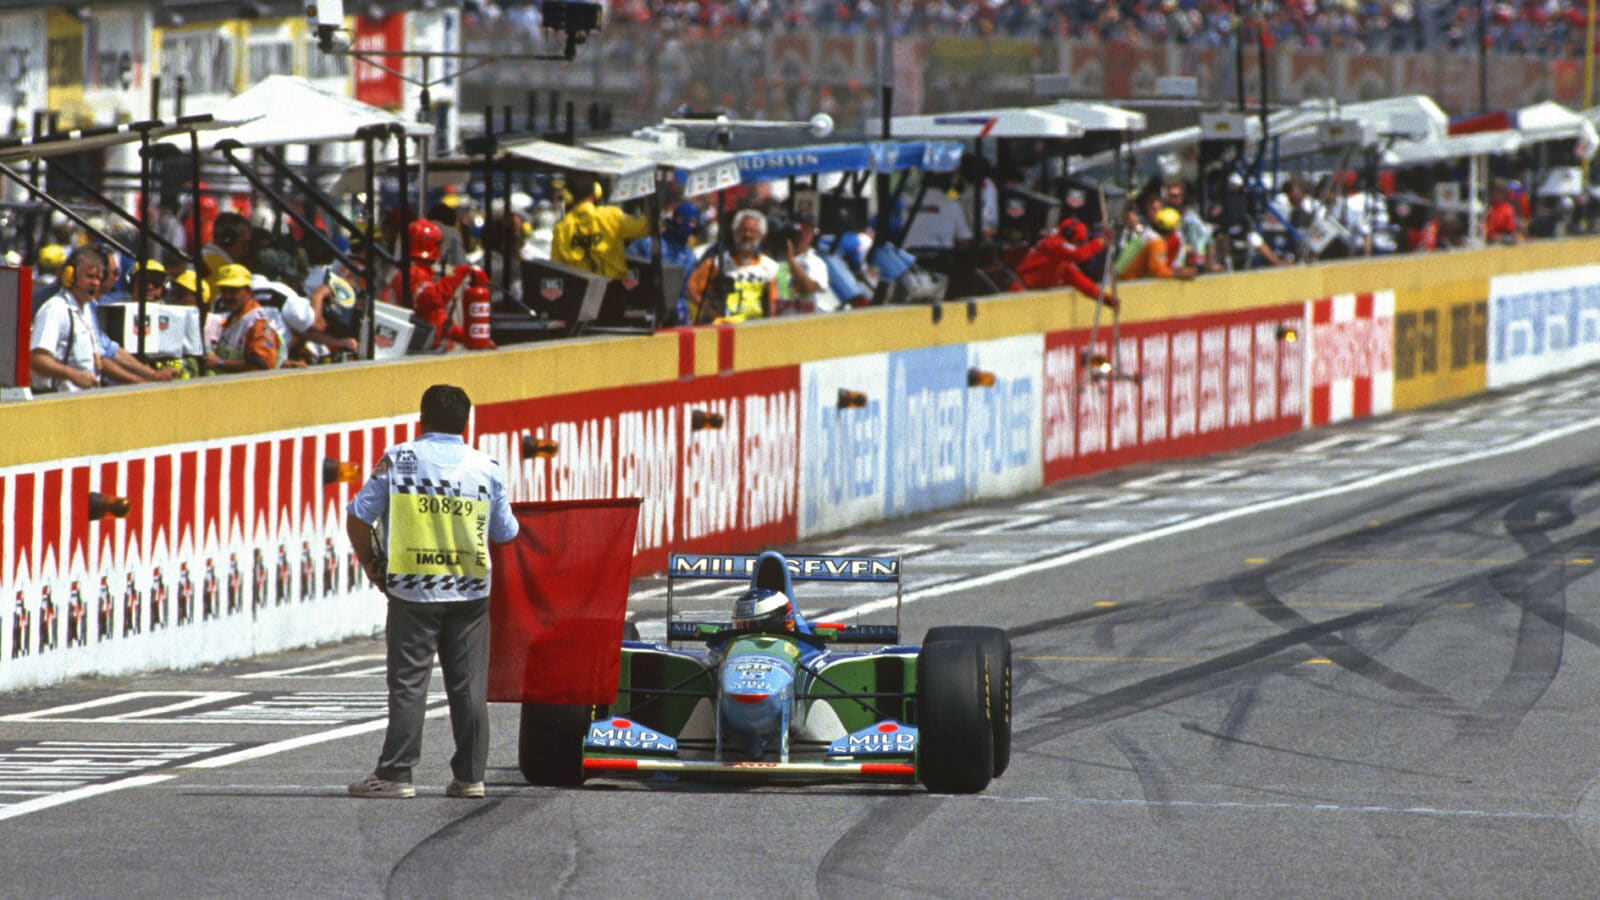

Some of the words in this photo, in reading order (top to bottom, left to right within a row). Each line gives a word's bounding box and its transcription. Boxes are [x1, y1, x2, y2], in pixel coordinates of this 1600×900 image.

[418, 497, 473, 516] 30829
[477, 514, 487, 547] LANE
[476, 550, 487, 567] PIT
[785, 558, 897, 576] SEVEN
[592, 728, 659, 741] MILD
[849, 733, 915, 745] MILD
[592, 739, 675, 750] SEVEN
[833, 744, 914, 753] SEVEN
